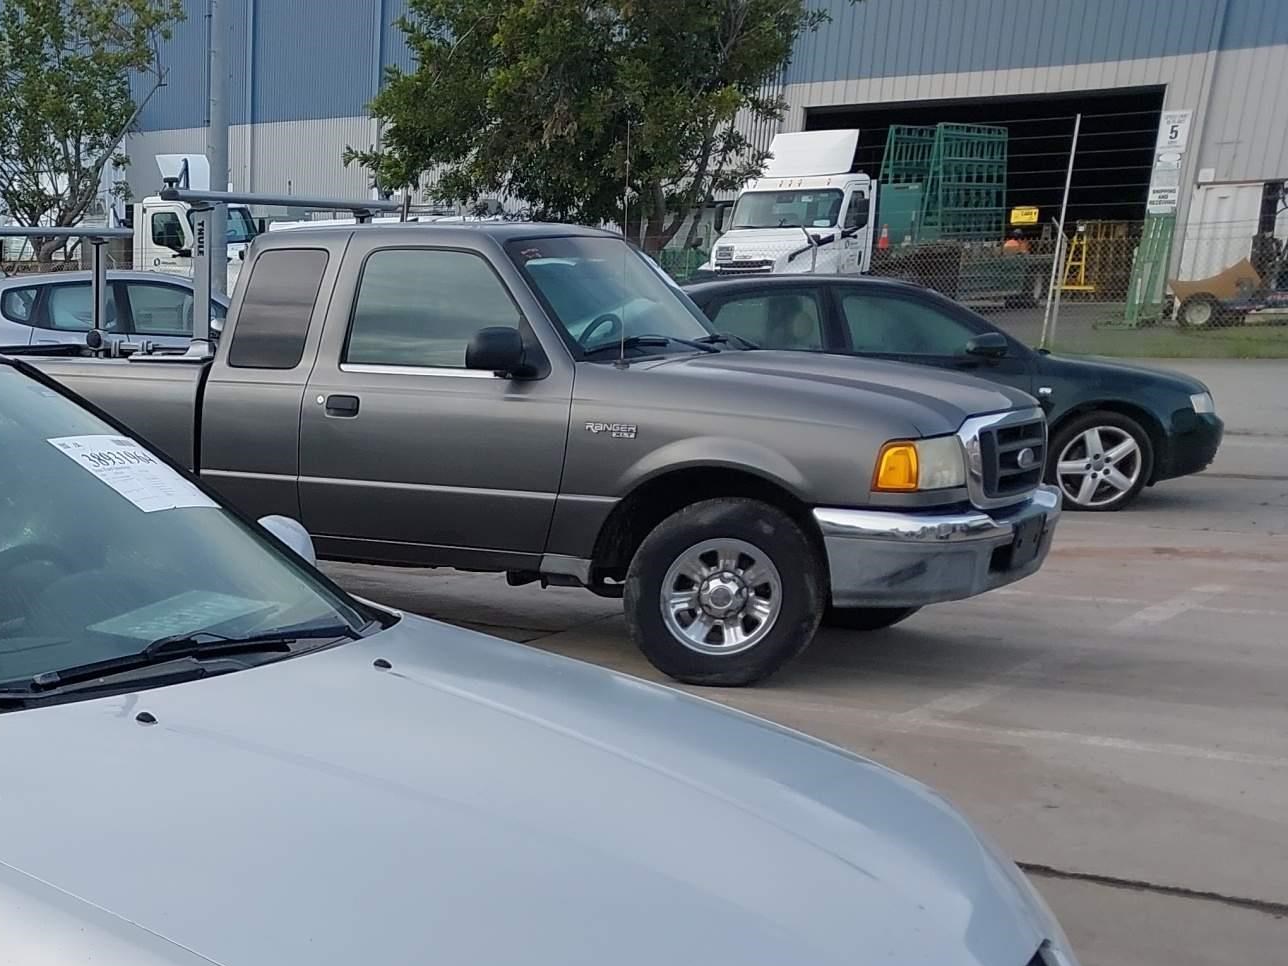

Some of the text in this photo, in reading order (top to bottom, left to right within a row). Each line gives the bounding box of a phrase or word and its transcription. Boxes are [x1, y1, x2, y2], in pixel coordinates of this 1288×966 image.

[1169, 125, 1179, 140] 5
[197, 220, 205, 257] THULE
[584, 422, 637, 433] RANGER
[81, 450, 158, 469] 38931964
